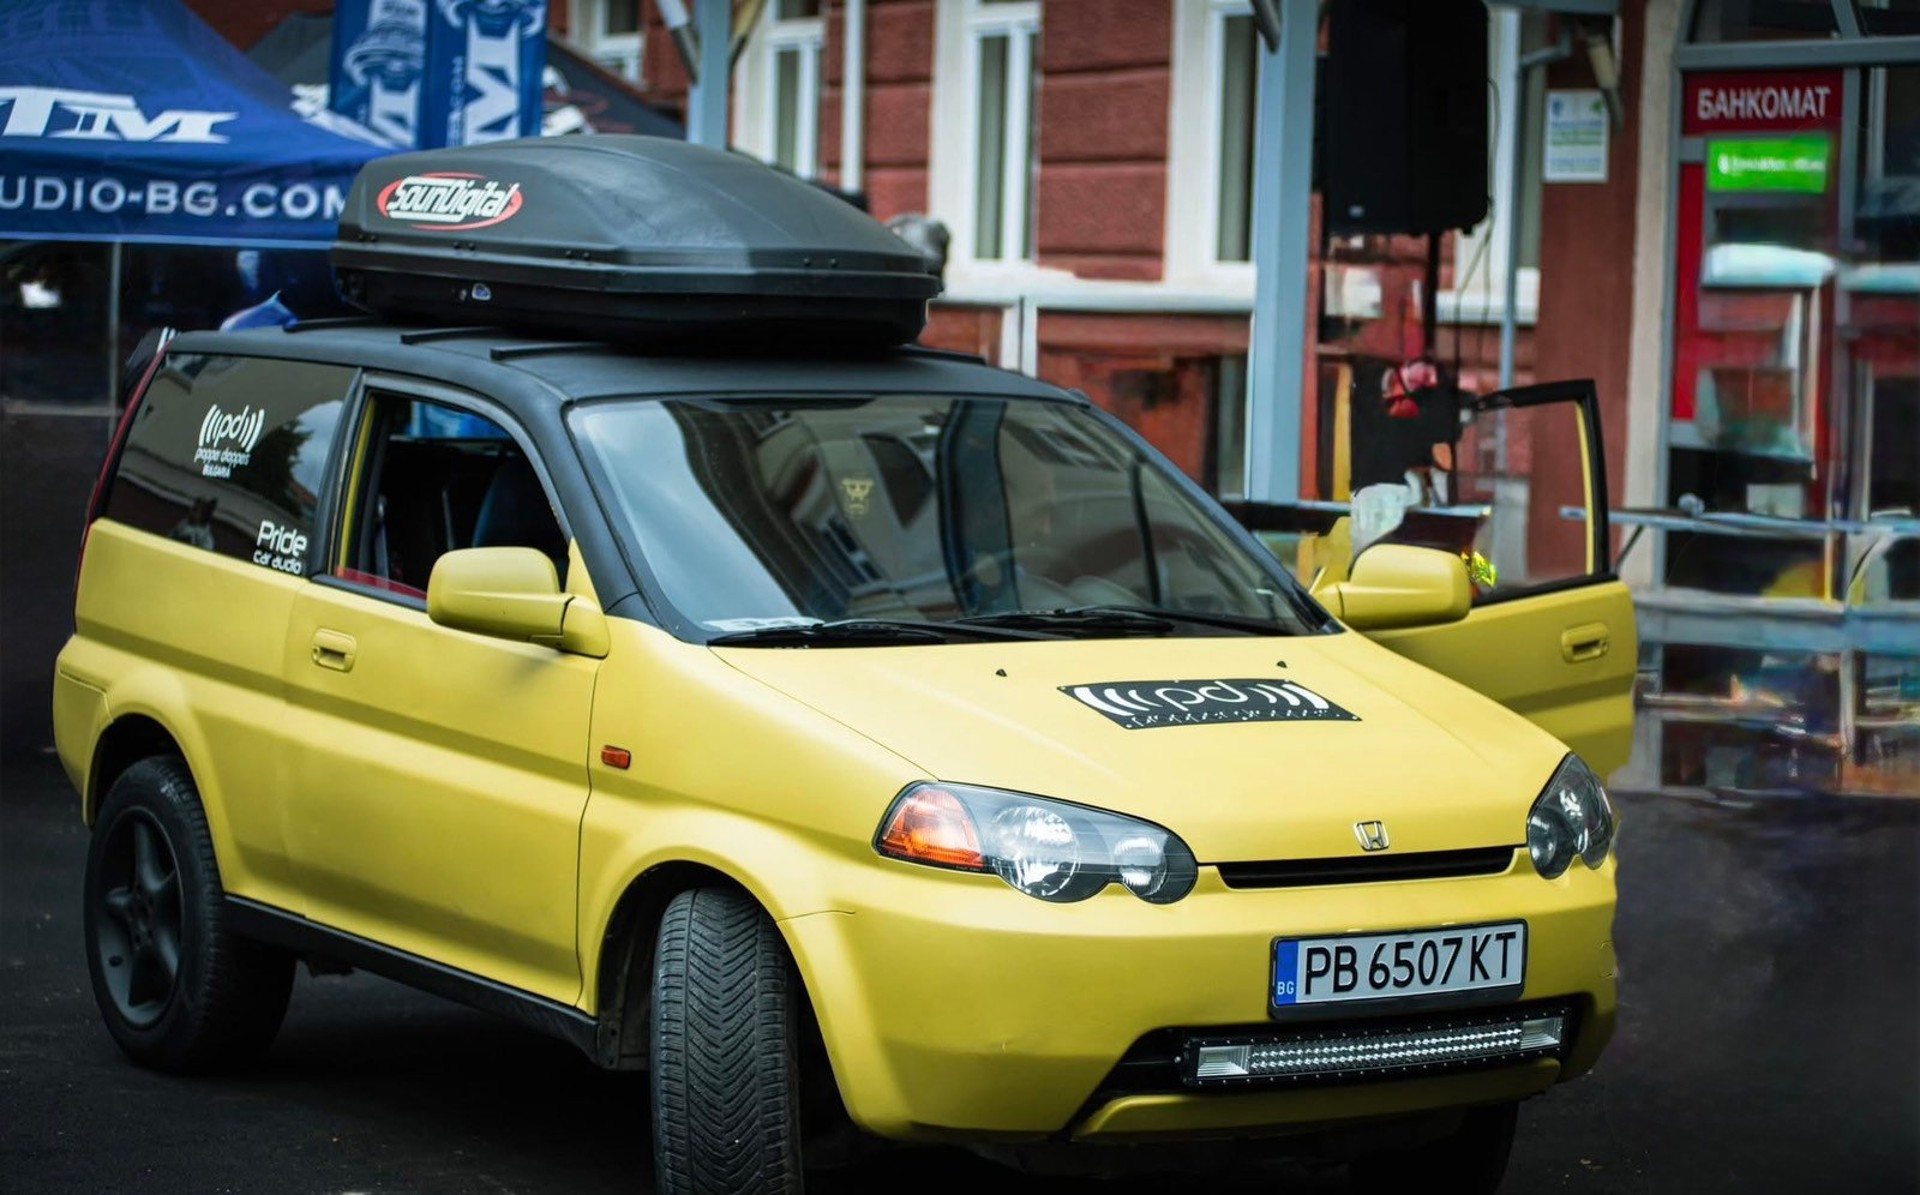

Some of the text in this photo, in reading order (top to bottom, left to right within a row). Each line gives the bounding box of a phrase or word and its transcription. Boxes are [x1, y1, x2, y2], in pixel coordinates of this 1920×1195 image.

[1697, 87, 1831, 119] БАНКОМАТ
[257, 520, 307, 556] Pride
[253, 550, 302, 574] car audio
[1368, 936, 1463, 990] 6507
[1277, 982, 1294, 995] BG
